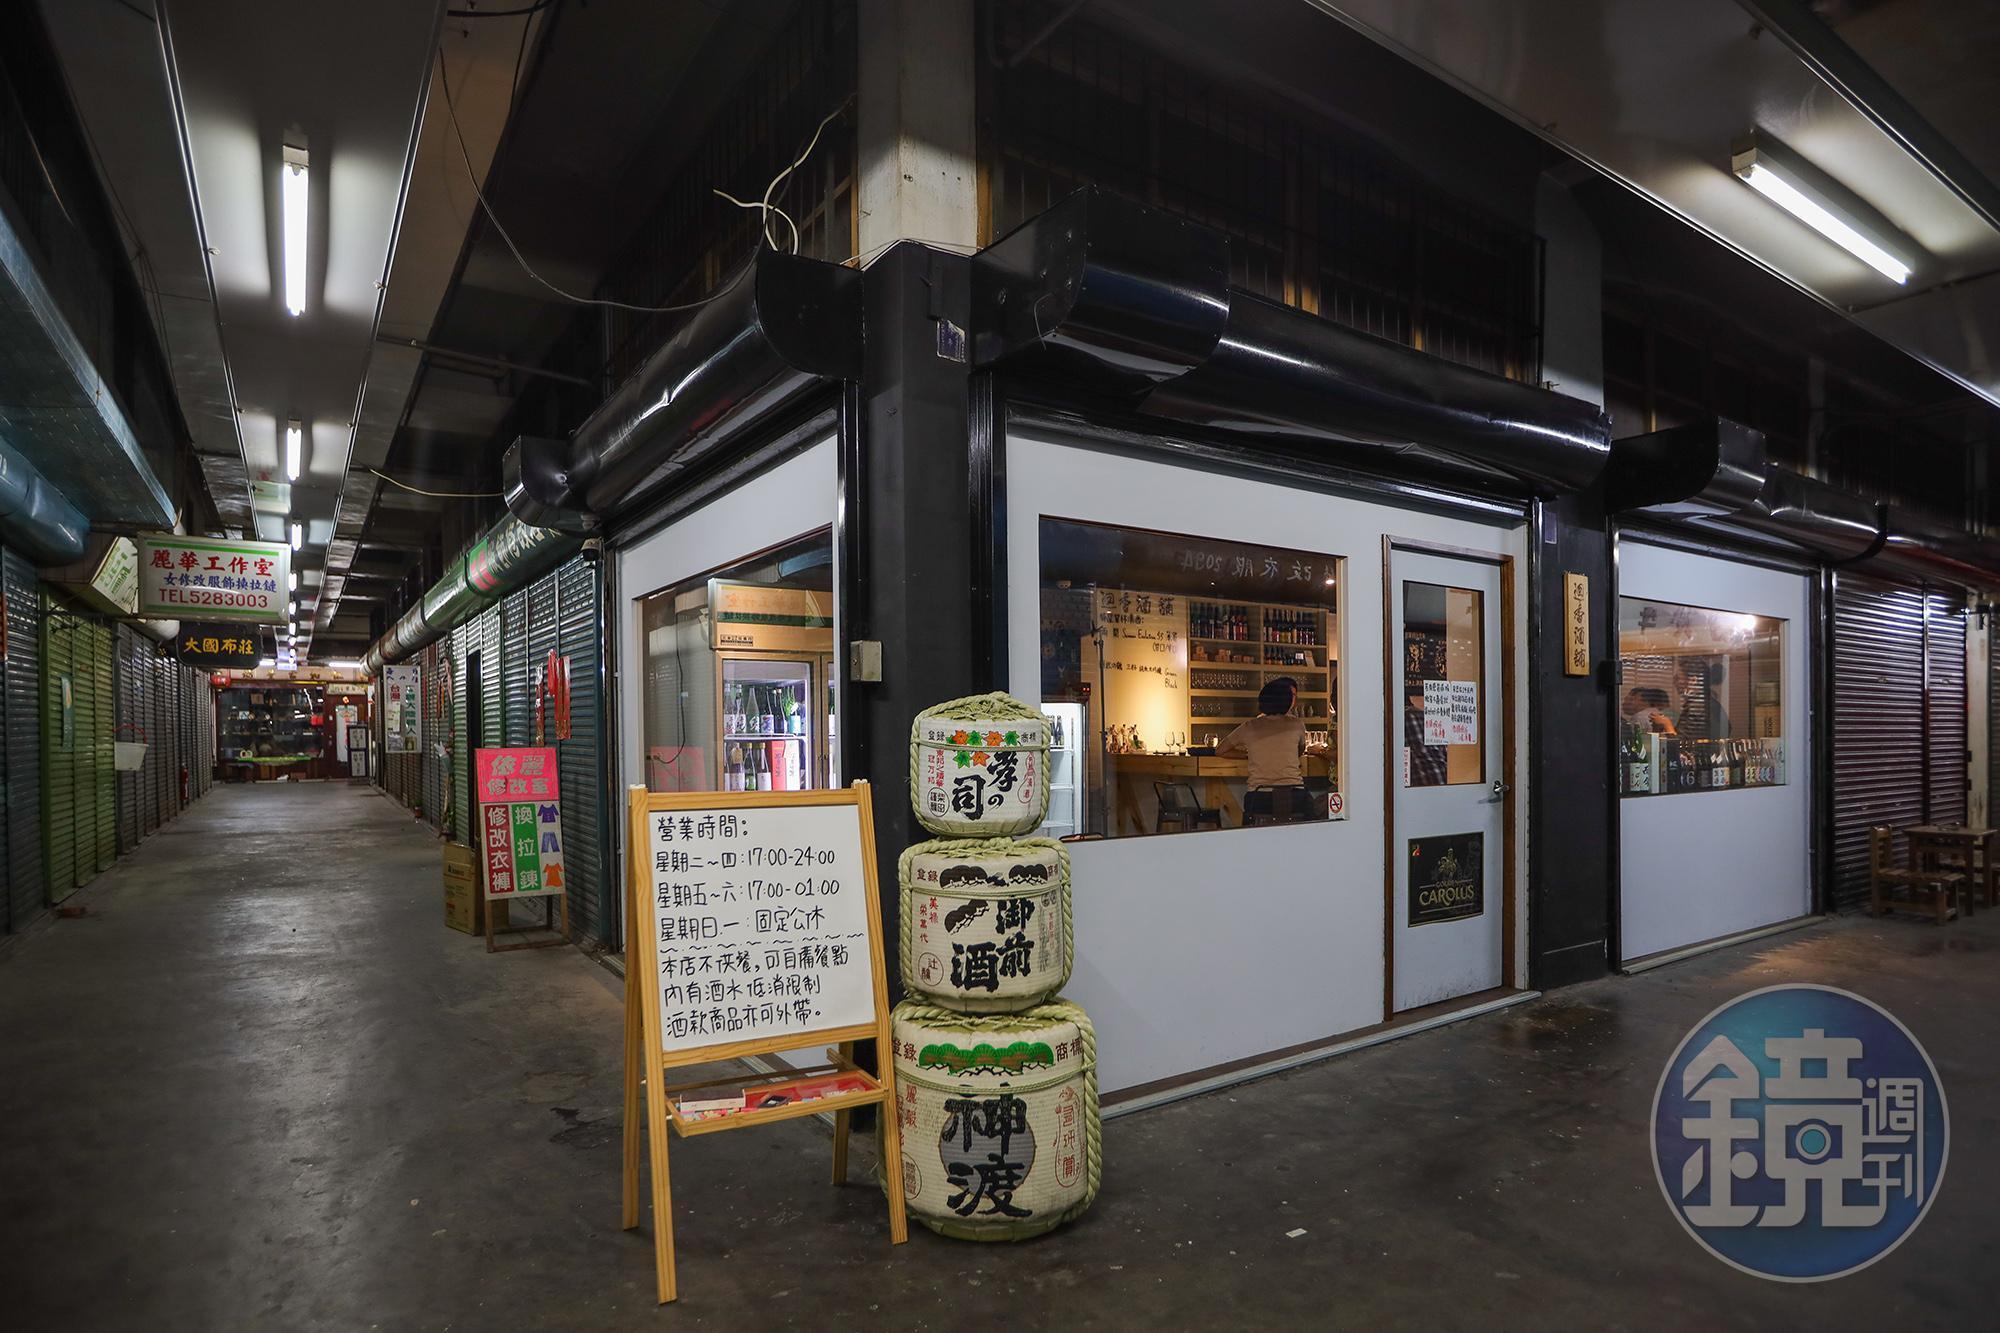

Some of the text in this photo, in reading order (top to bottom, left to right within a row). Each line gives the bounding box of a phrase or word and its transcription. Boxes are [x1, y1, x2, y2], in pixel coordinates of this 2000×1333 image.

[150, 549, 275, 577] 麗華工作室
[159, 588, 269, 608] TEL5283003
[183, 636, 255, 655] 大國布莊
[487, 806, 512, 892] 修改衣褲
[514, 805, 540, 890] 換拉鍊
[1418, 884, 1475, 906] CAROLUS
